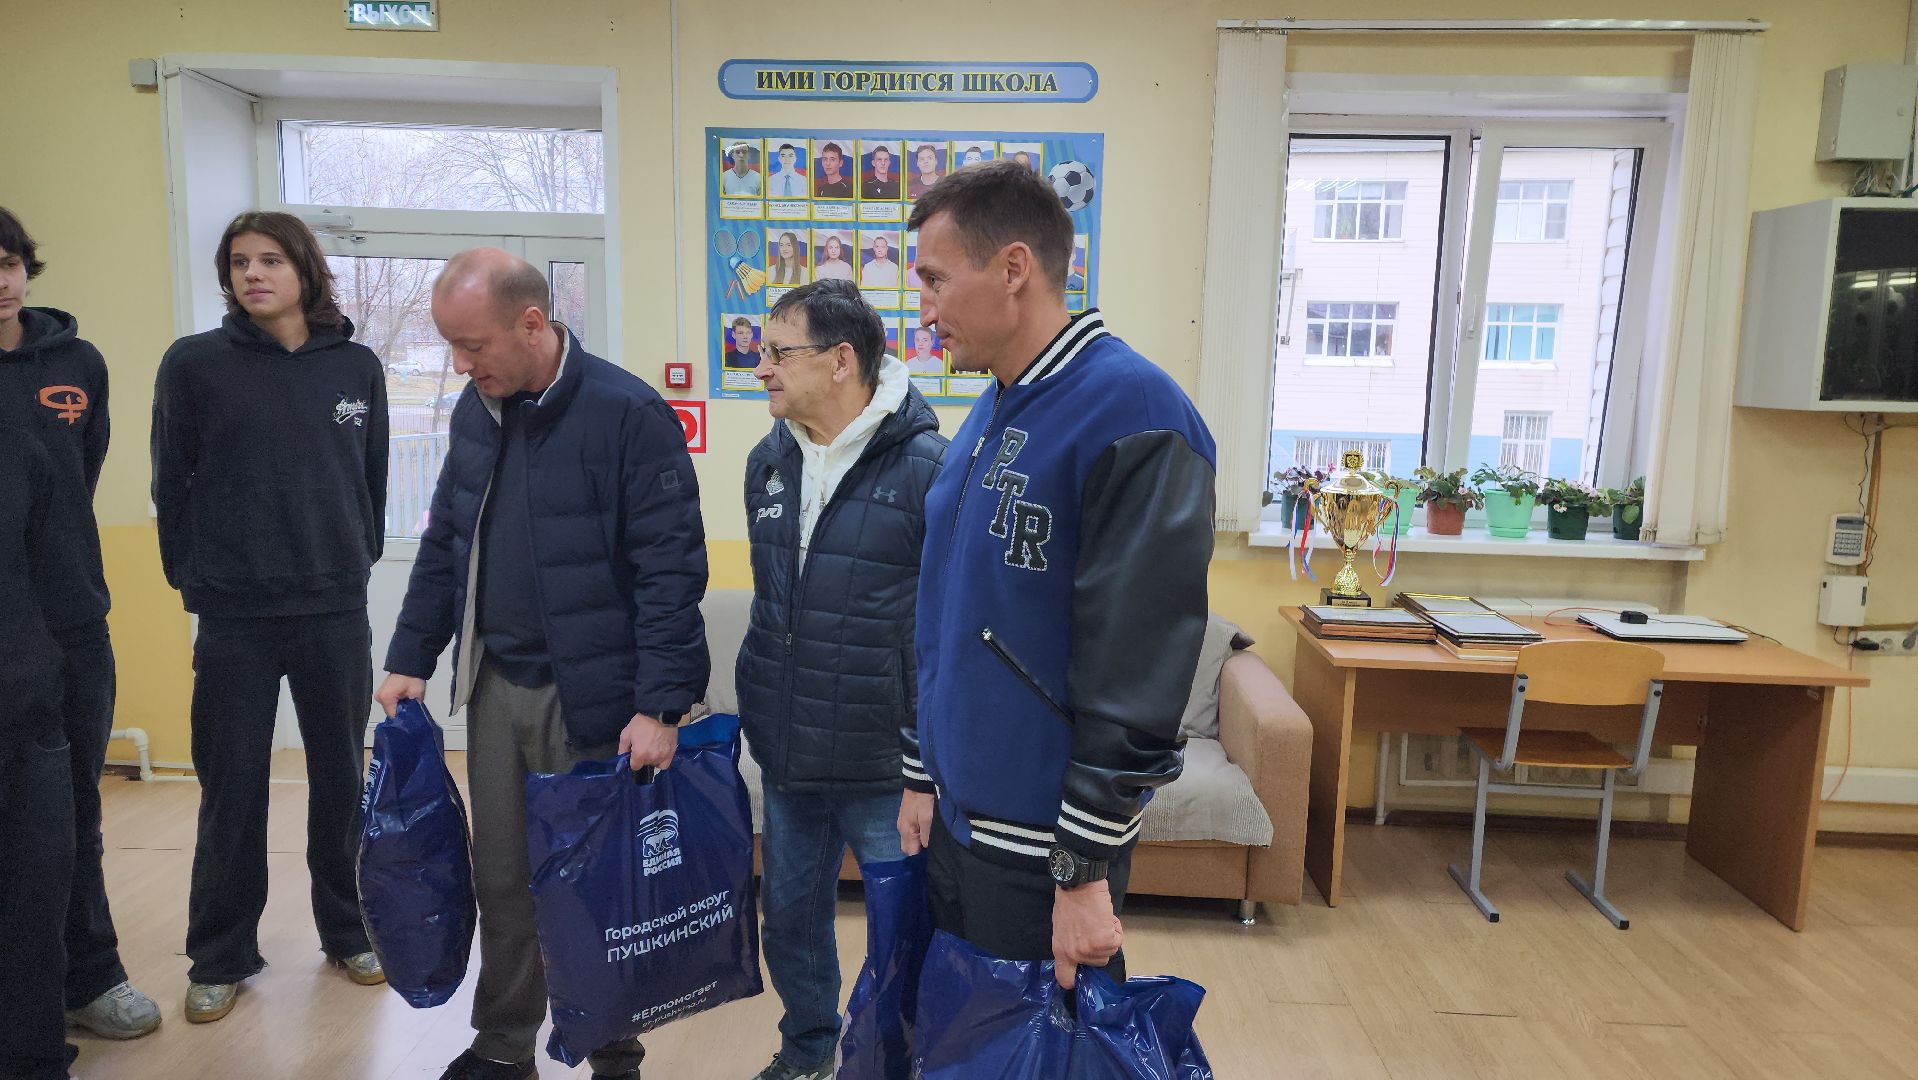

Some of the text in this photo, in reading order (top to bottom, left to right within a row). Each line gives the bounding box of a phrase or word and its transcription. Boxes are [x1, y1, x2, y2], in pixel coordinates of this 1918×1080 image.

[353, 3, 428, 23] ВЫХОД
[755, 70, 1059, 94] ИМИ ГОРДИТСЯ ШКОЛА
[643, 847, 681, 868] ЕДИНАЯ
[643, 856, 683, 877] РОССИЯ
[604, 890, 730, 941] Городской округ
[607, 903, 734, 963] ПУШКИНСКИЙ
[631, 980, 718, 1023] #ЕРпомогает
